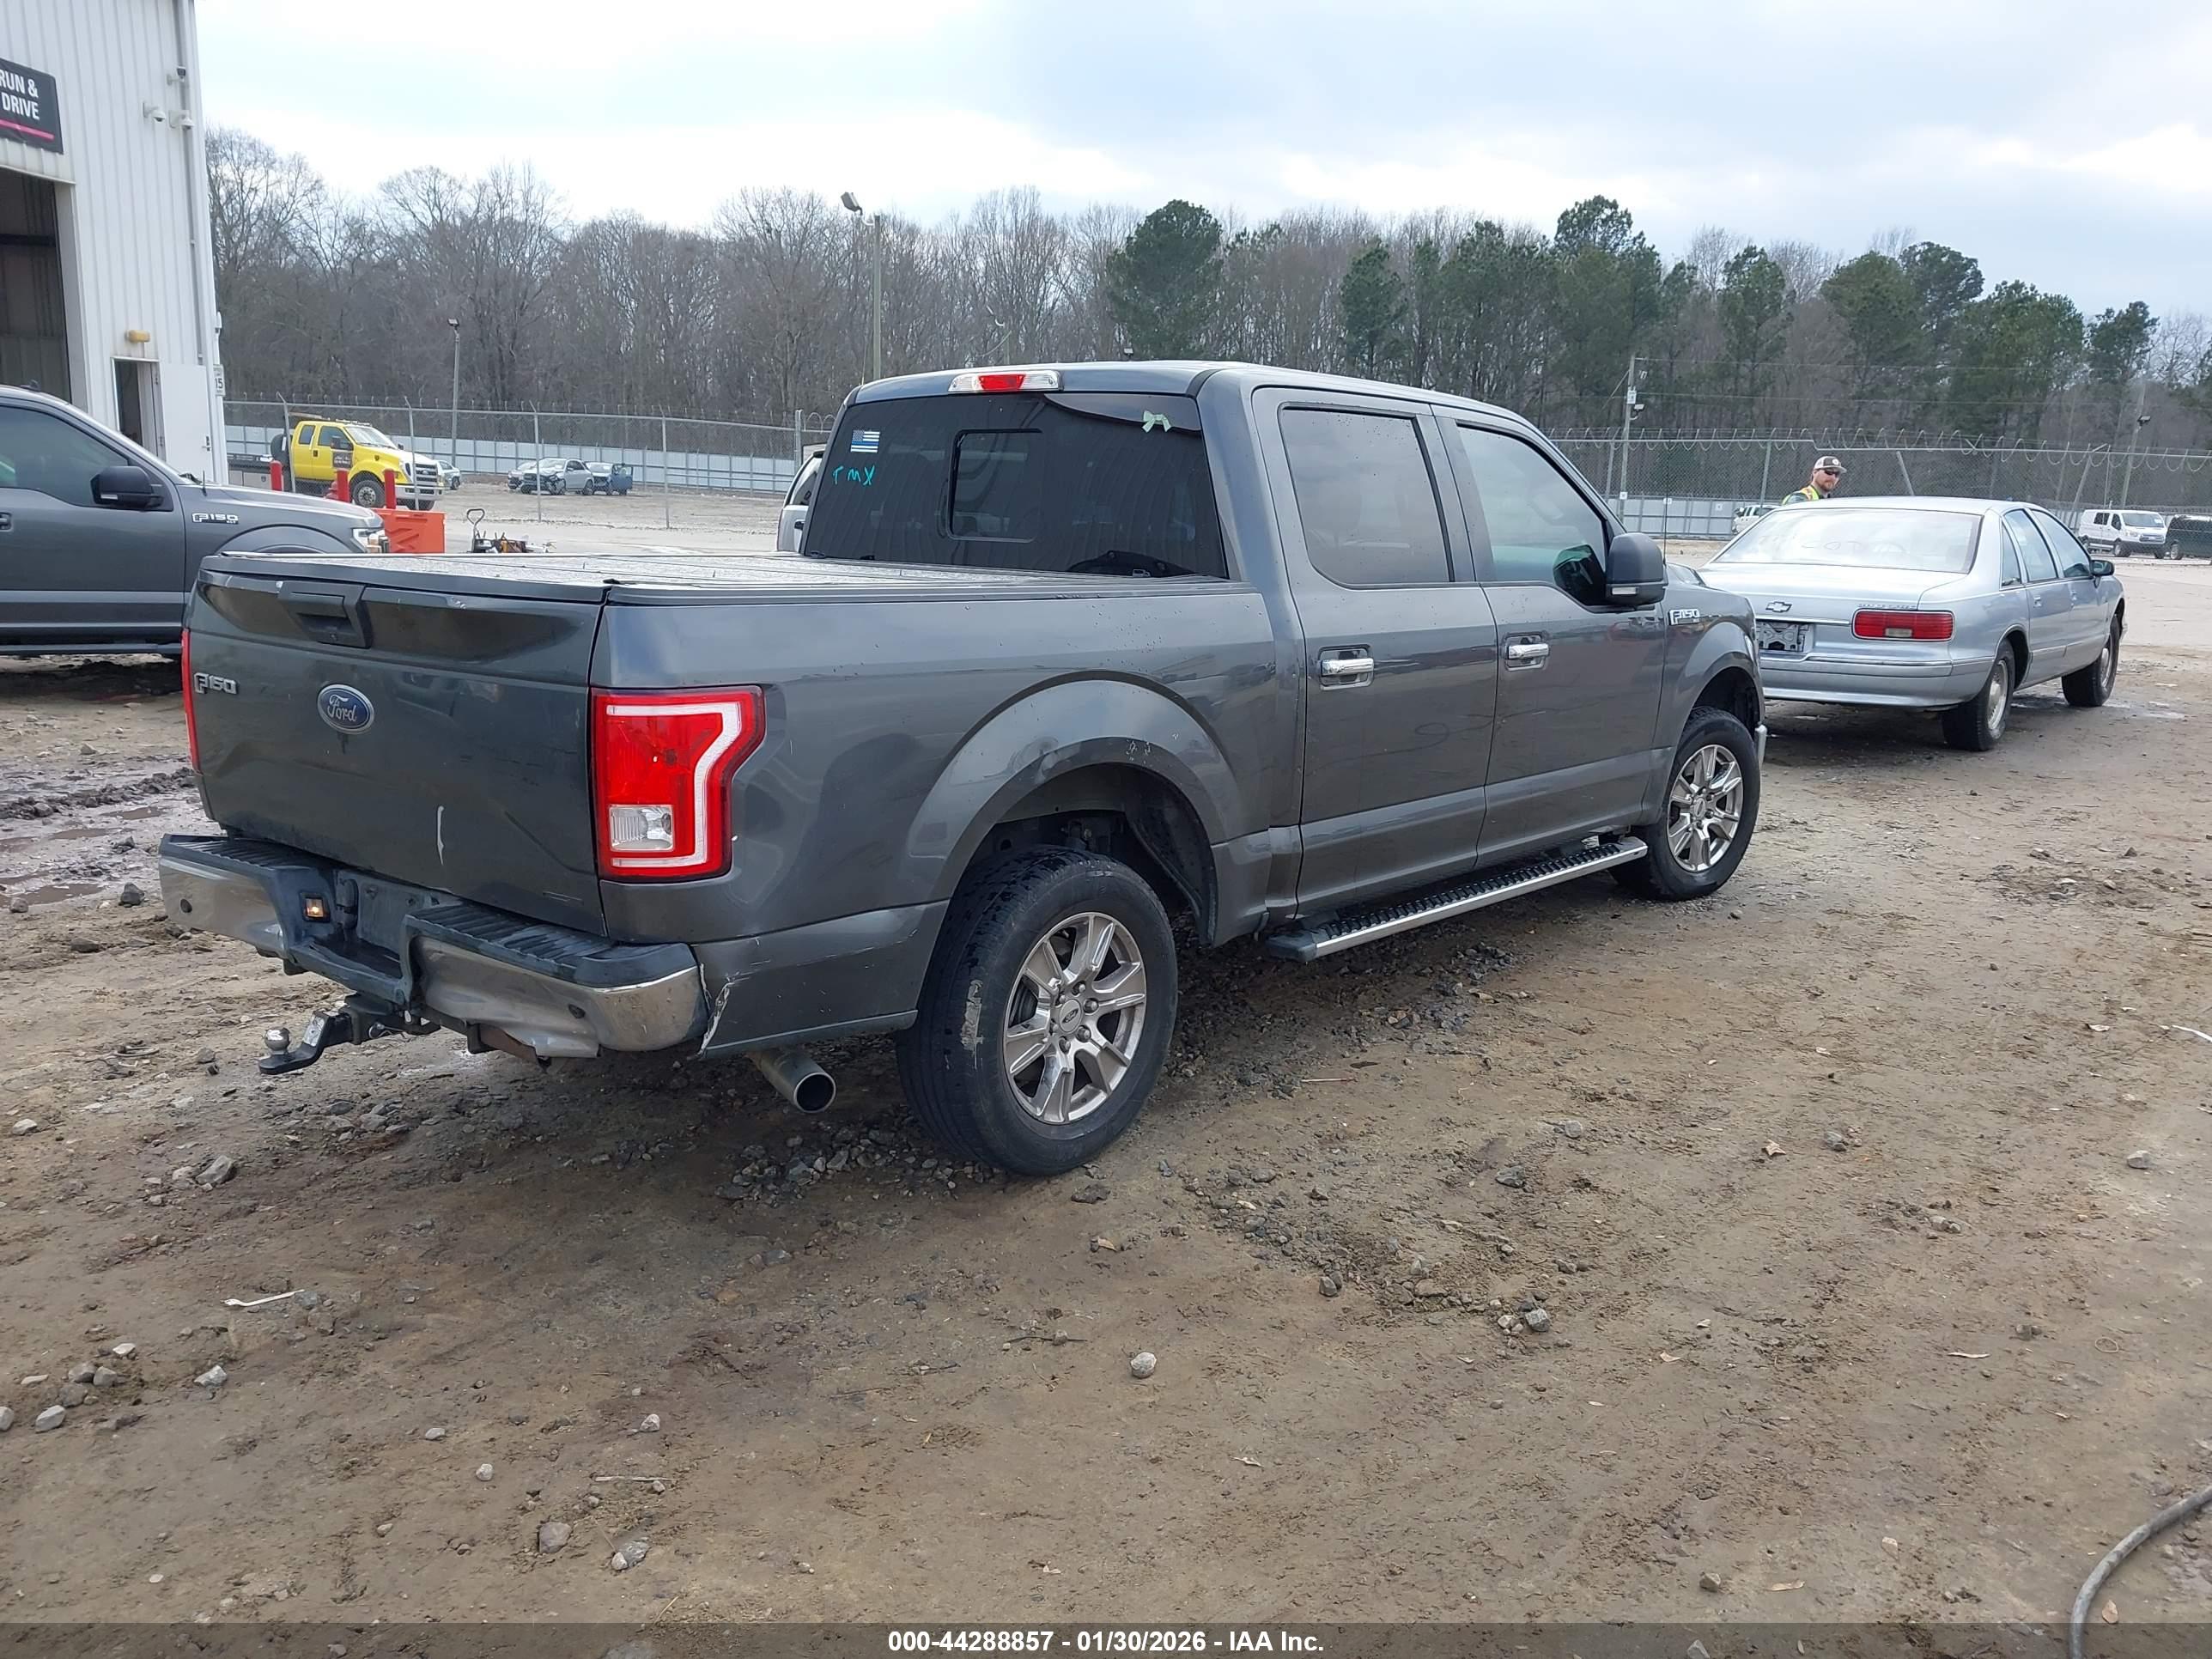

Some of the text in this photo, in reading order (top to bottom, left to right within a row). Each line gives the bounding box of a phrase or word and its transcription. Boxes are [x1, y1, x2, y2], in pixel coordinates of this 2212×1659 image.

[0, 70, 39, 98] RUN &
[1, 91, 40, 120] DRIVE
[327, 694, 357, 721] Ford
